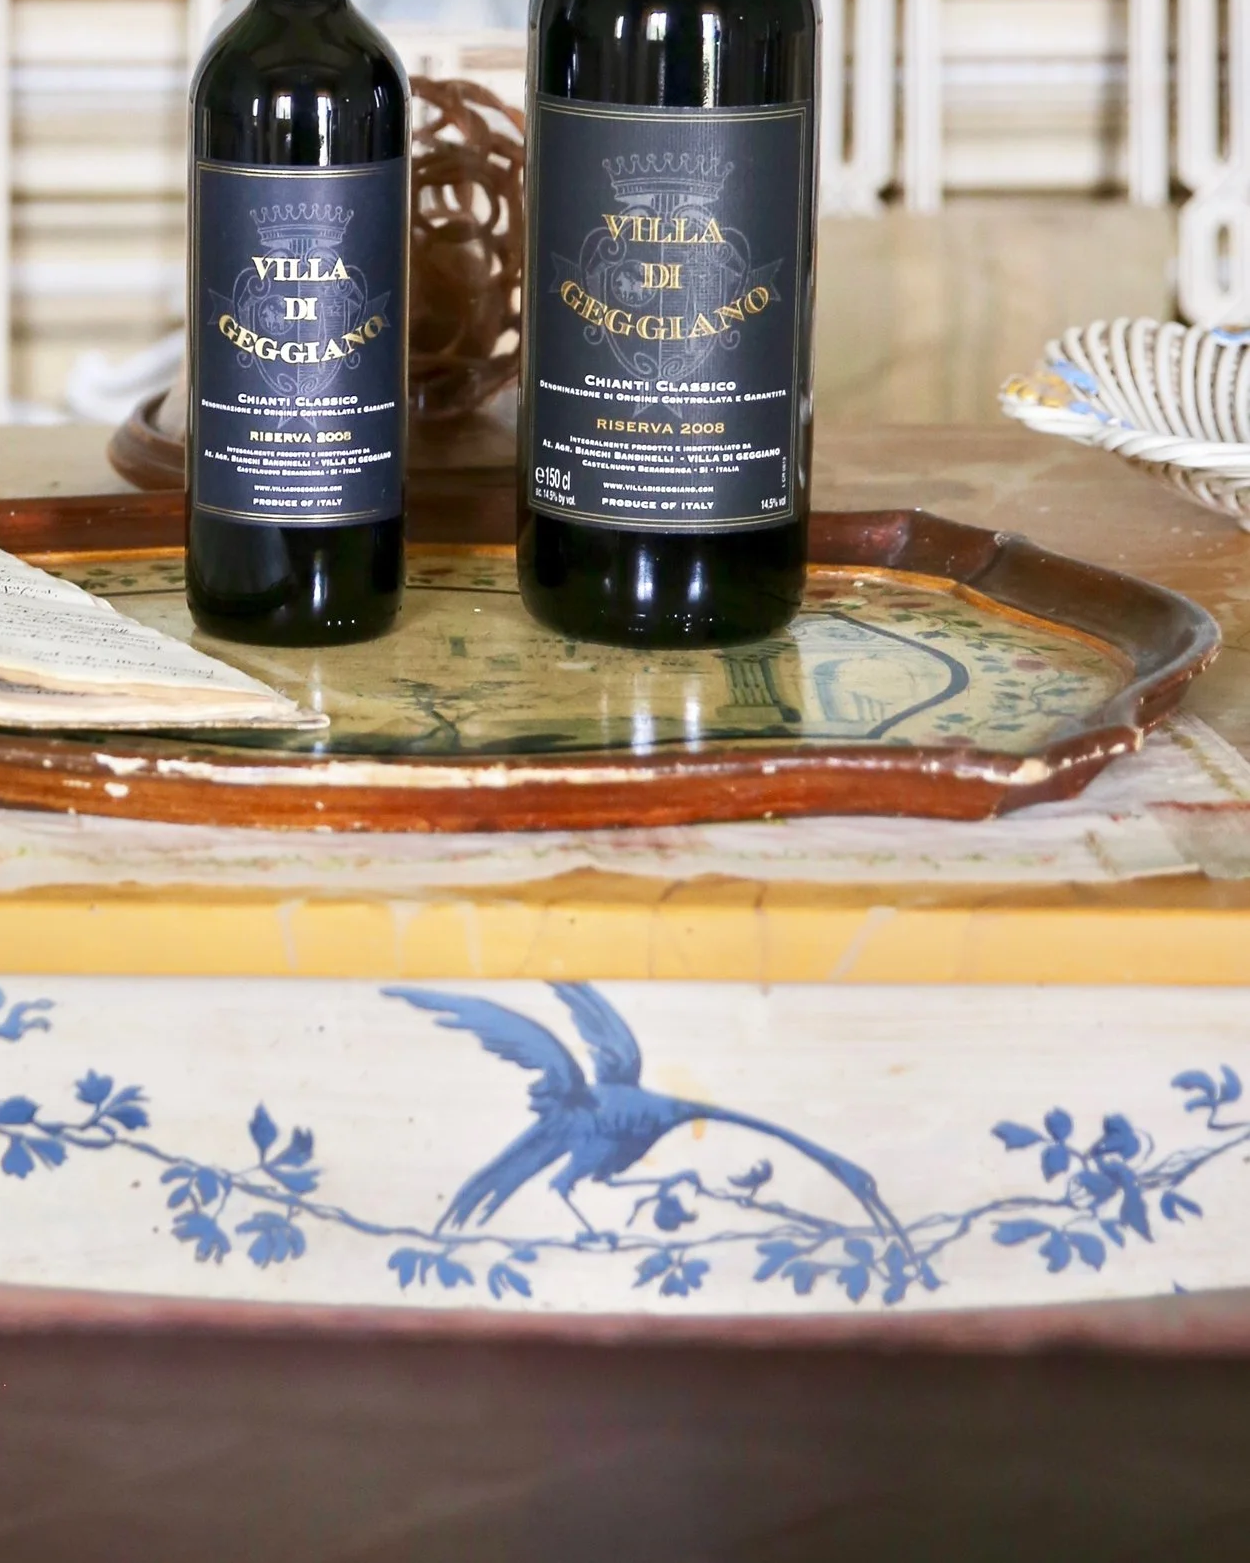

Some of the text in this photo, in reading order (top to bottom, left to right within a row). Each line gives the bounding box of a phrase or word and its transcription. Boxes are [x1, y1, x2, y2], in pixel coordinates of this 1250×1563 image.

[601, 213, 726, 244] VILLA
[251, 255, 350, 282] VILLA
[641, 262, 684, 289] DI
[283, 297, 318, 320] DI
[560, 280, 770, 340] GEGGIANO
[218, 314, 384, 364] GEGGIANO
[539, 379, 787, 405] DENOMINAZIONE DI ORIGINE CONTROLLATA E GARANTITA
[584, 374, 737, 393] CHIANTI CLASSICO
[237, 393, 358, 407] CHIANTI CLASSICO
[263, 408, 298, 417] ORIGINE
[299, 407, 355, 417] CONTROLLATA
[596, 418, 725, 434] RISERVA 2008
[249, 430, 352, 444] RISERVA 2008
[570, 435, 629, 451] INTEGRALMENTE
[631, 443, 673, 452] PRODOTTO
[683, 444, 741, 452] IMBOTTIGLIATO
[231, 454, 261, 466] BIANCHI
[262, 458, 311, 467] BANDINELLI
[321, 458, 347, 467] VILLA
[348, 457, 357, 465] DI
[358, 451, 392, 464] GEGGIANO
[542, 439, 781, 463] AZ. AGR. BIANCHI BANDINELLI VILLA DI GEGGIANO
[582, 459, 636, 472] CASTELNUOVO
[638, 465, 692, 474] BERARDENGA
[253, 497, 343, 507] PRODUCE OF ITALY
[601, 497, 714, 510] PRODUCE OF ITALY
